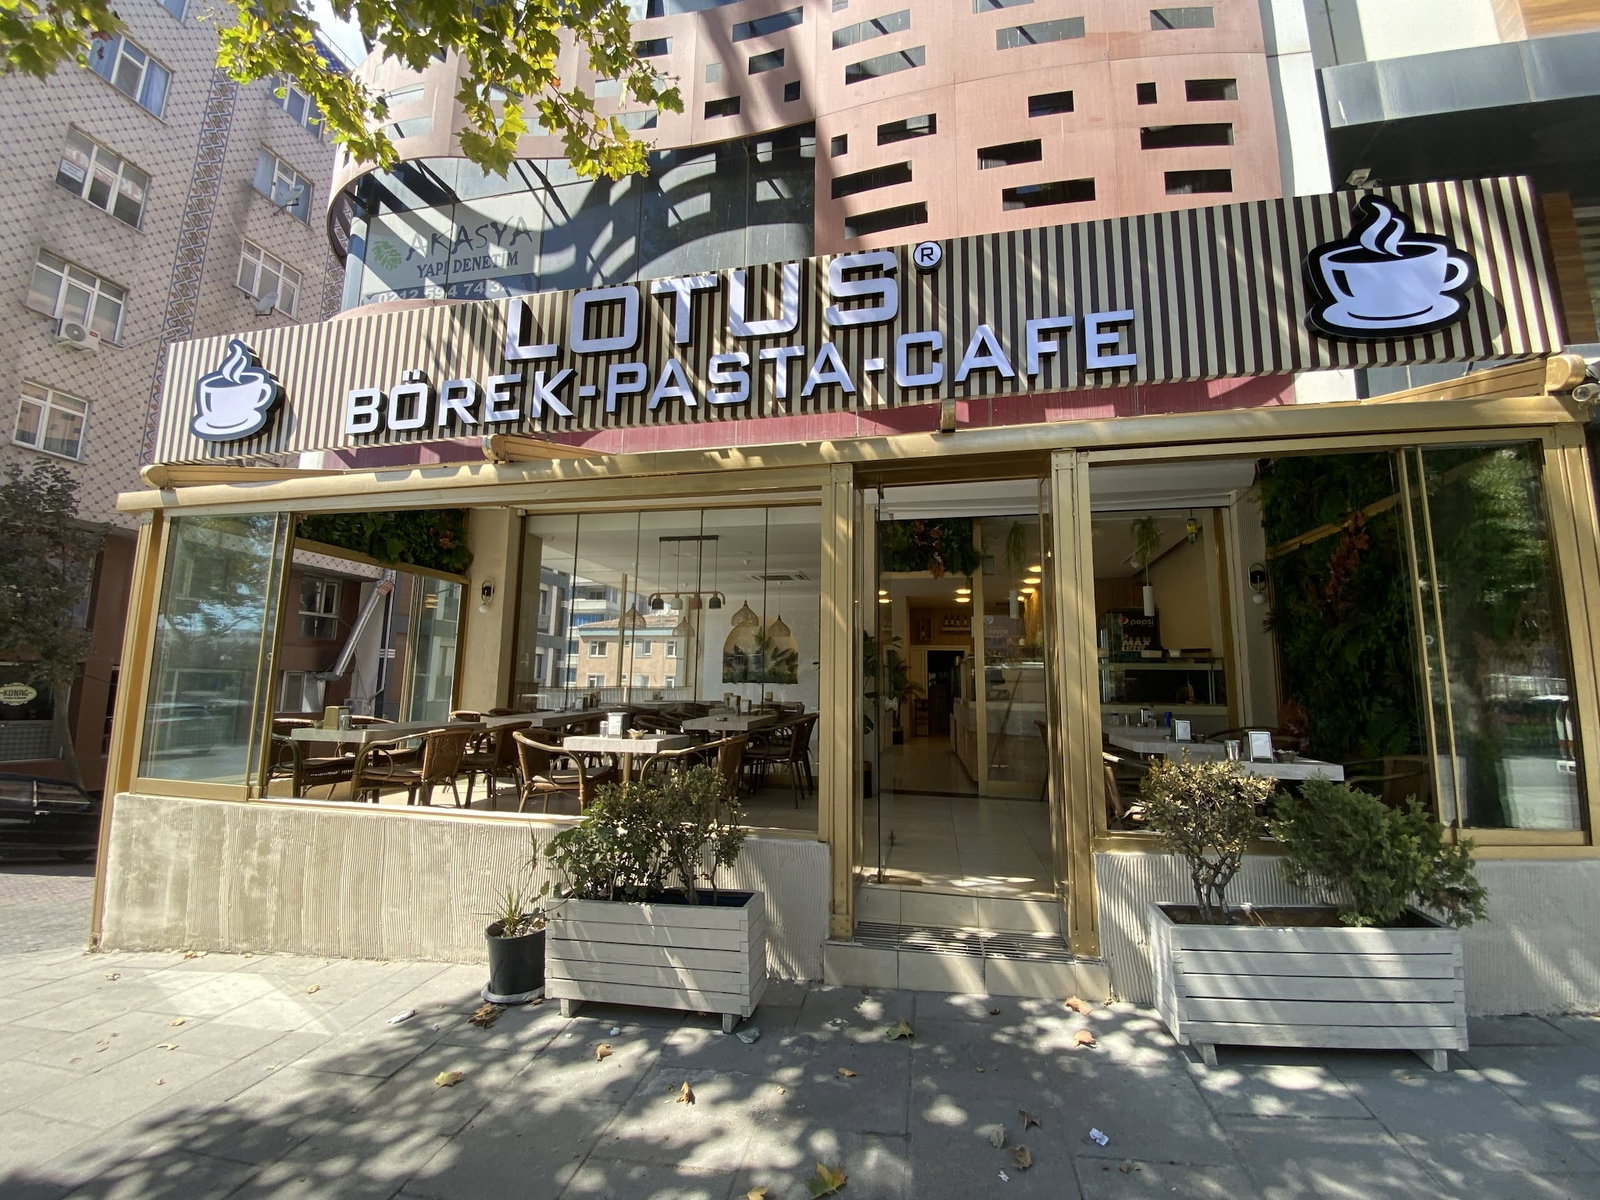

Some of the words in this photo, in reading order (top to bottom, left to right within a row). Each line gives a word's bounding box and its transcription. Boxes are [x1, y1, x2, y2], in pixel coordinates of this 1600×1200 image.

[406, 215, 533, 261] AKASYA
[417, 260, 449, 279] YAPI
[452, 251, 519, 274] DENETİM
[463, 282, 485, 296] 74
[505, 250, 899, 361] LOTUS
